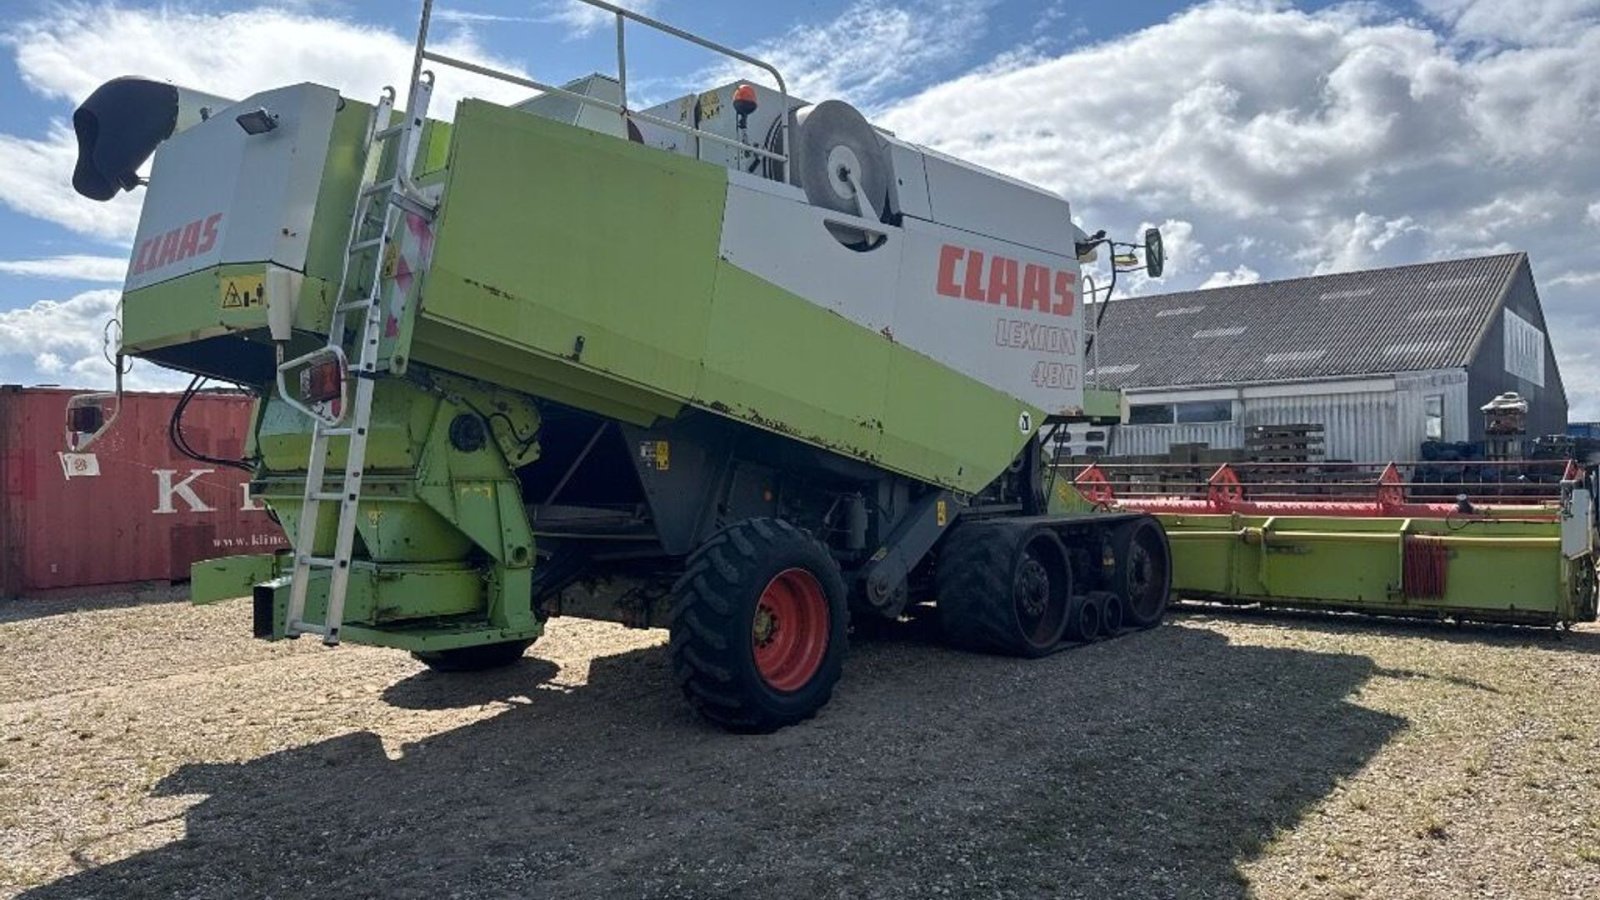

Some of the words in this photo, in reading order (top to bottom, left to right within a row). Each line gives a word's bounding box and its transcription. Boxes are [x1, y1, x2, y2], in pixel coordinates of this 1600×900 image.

[133, 212, 223, 275] CLAAS
[937, 244, 1076, 317] CLAAS
[995, 318, 1078, 355] LEXION
[1031, 360, 1078, 390] 480
[152, 469, 217, 513] K
